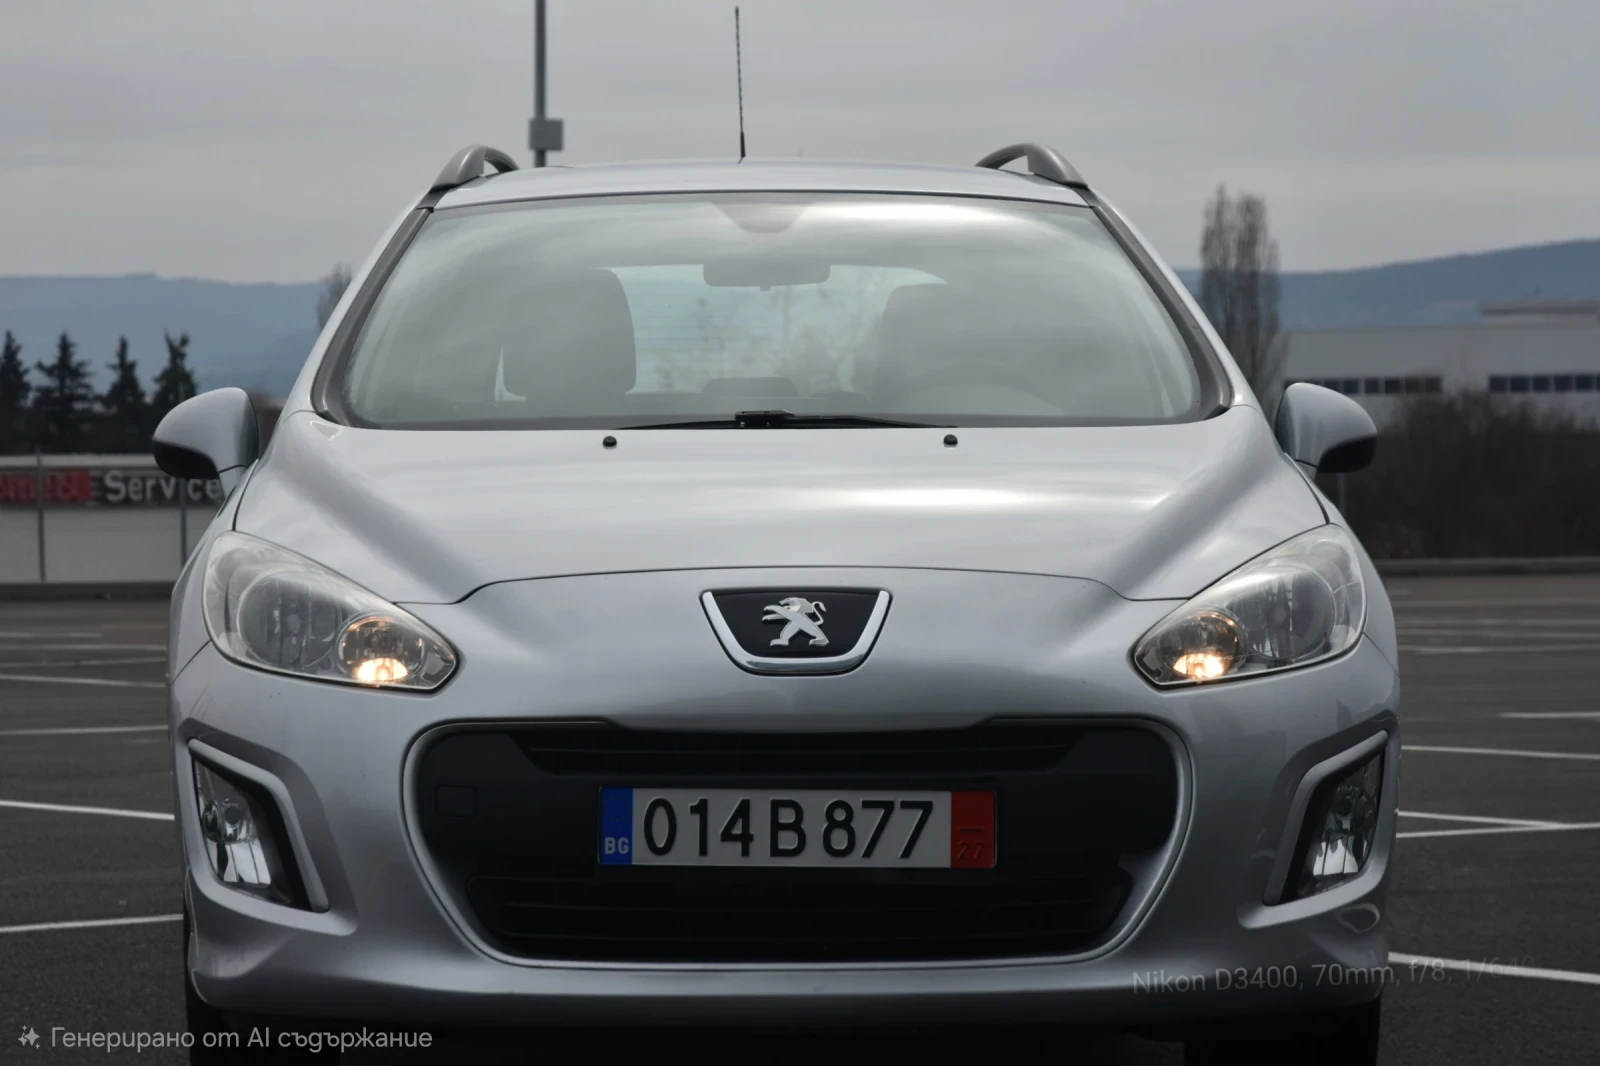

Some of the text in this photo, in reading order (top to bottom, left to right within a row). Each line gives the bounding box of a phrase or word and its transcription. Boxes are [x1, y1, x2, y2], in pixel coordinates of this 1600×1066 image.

[104, 469, 220, 502] Servce
[603, 837, 630, 855] BG
[957, 840, 985, 861] 27
